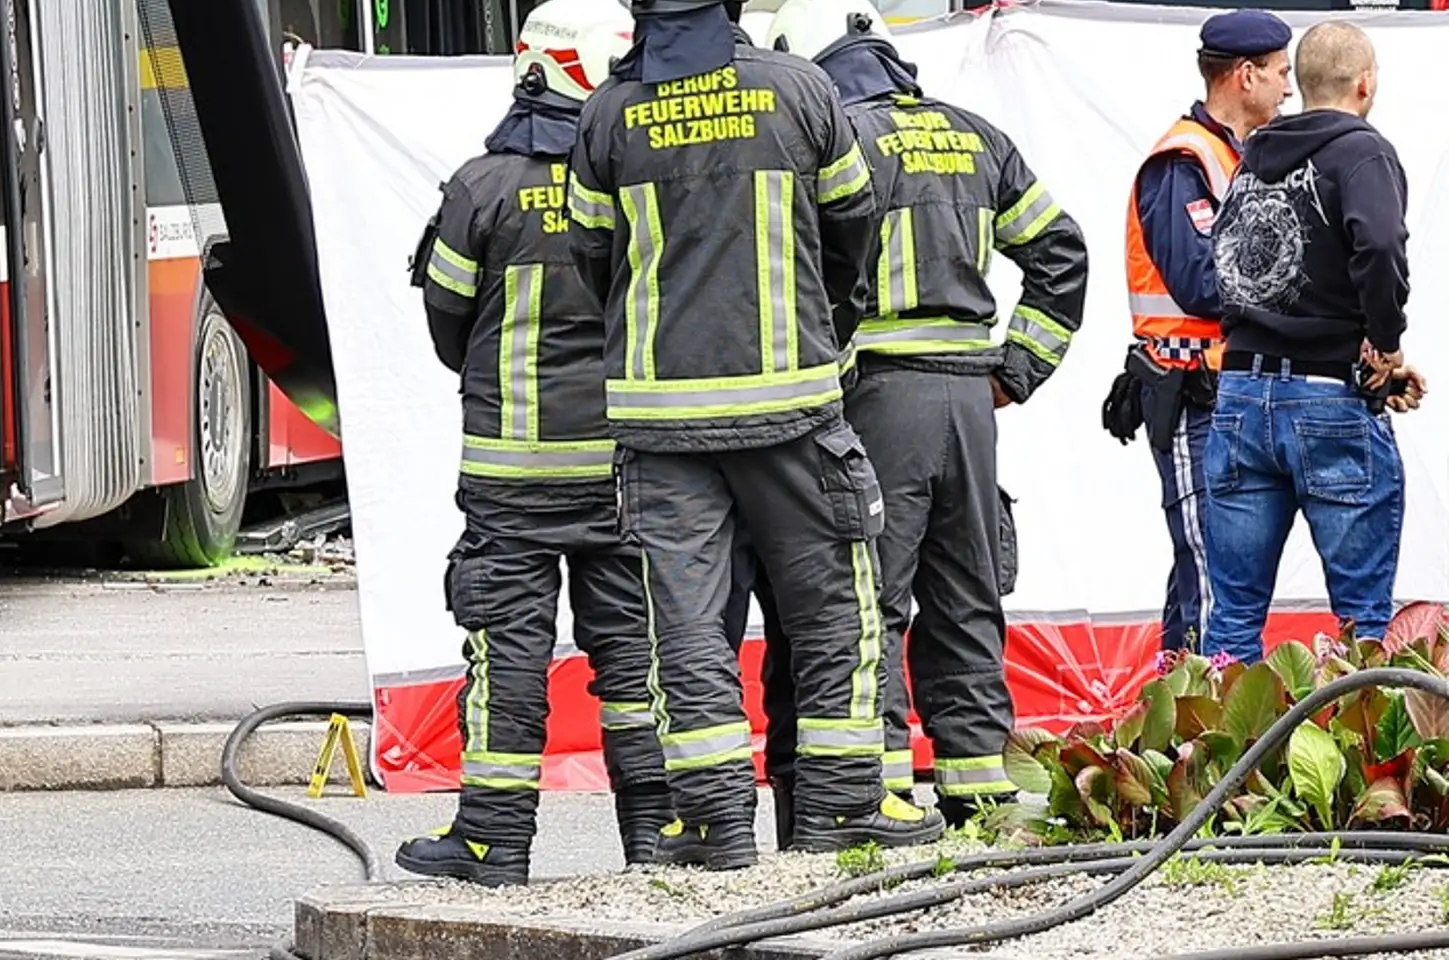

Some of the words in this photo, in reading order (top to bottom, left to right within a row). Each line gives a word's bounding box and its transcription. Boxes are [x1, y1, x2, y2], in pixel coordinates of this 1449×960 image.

[657, 66, 738, 97] BERUFS
[624, 89, 775, 129] FEUERWEHR
[648, 114, 755, 149] SALZBURG
[876, 130, 984, 157] FEUERWEHR
[901, 151, 975, 174] SALZBURG
